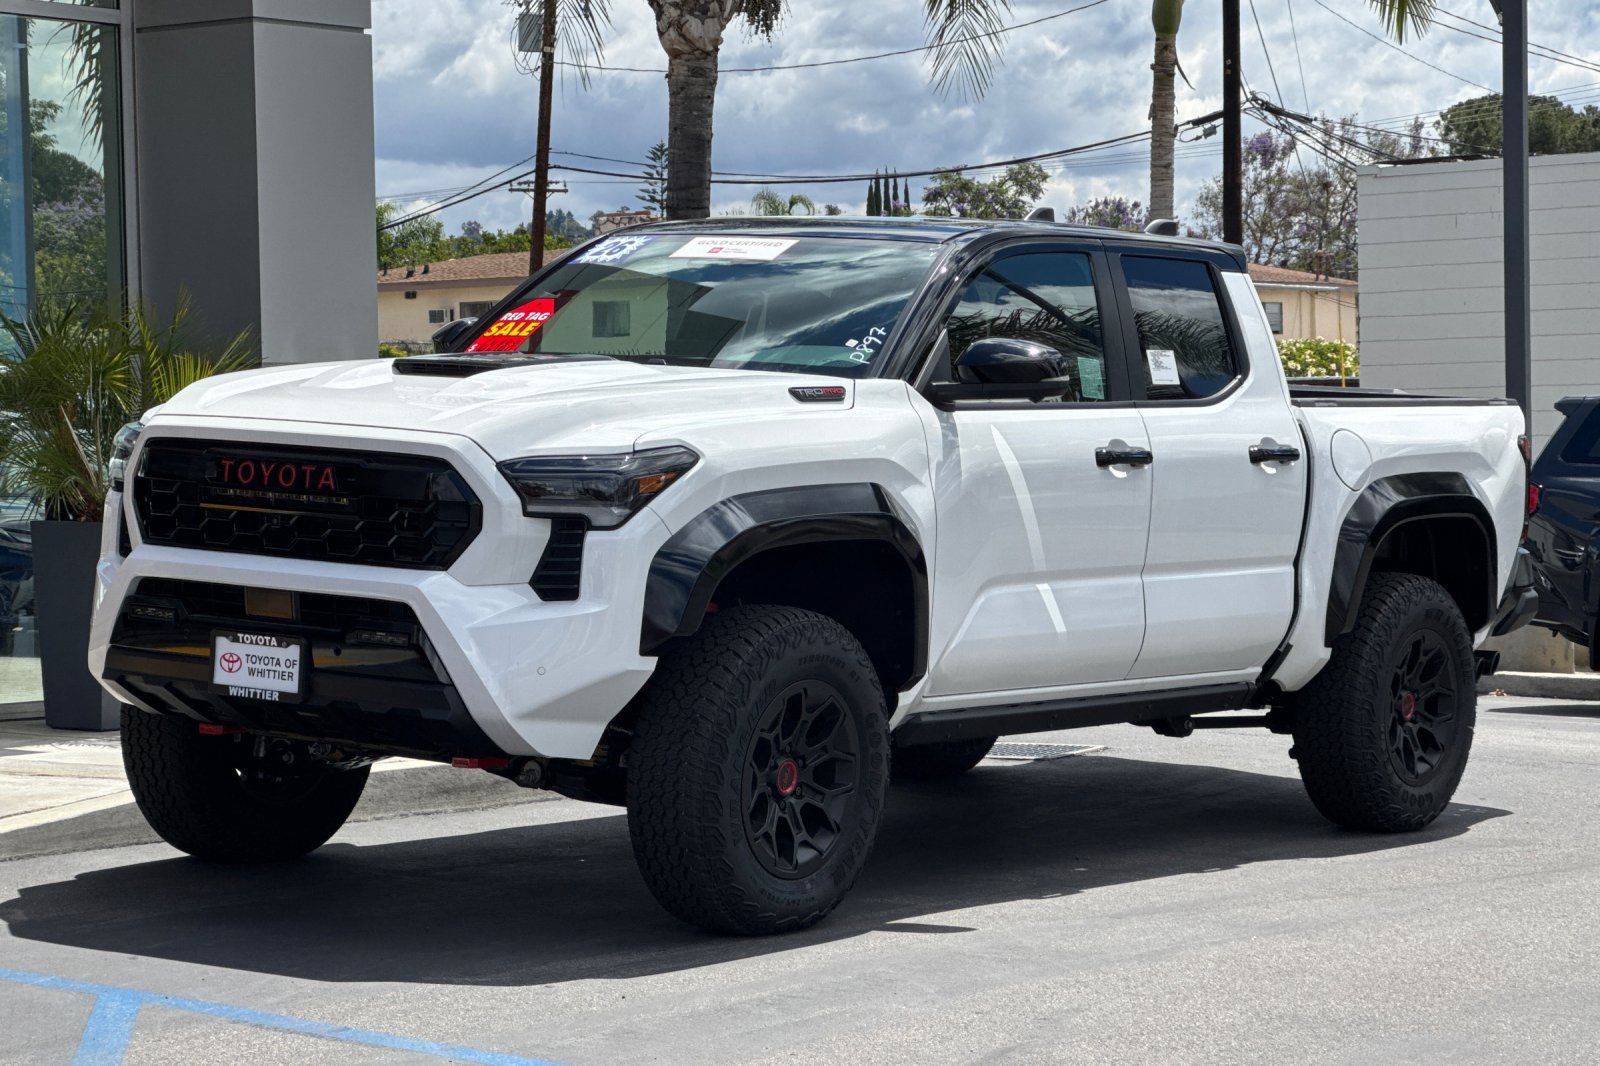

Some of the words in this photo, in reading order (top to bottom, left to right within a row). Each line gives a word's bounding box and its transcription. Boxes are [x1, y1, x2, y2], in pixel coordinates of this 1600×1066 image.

[729, 240, 784, 248] CERTIFIED
[500, 312, 525, 321] RED
[525, 312, 551, 321] TAG
[483, 321, 541, 337] SALE
[222, 460, 336, 490] TOYOTA
[237, 633, 278, 647] TOYOTA
[245, 654, 281, 668] TOYOTA
[284, 659, 298, 670] OF
[247, 667, 294, 682] WHITTIER
[228, 686, 279, 701] WHITTIER
